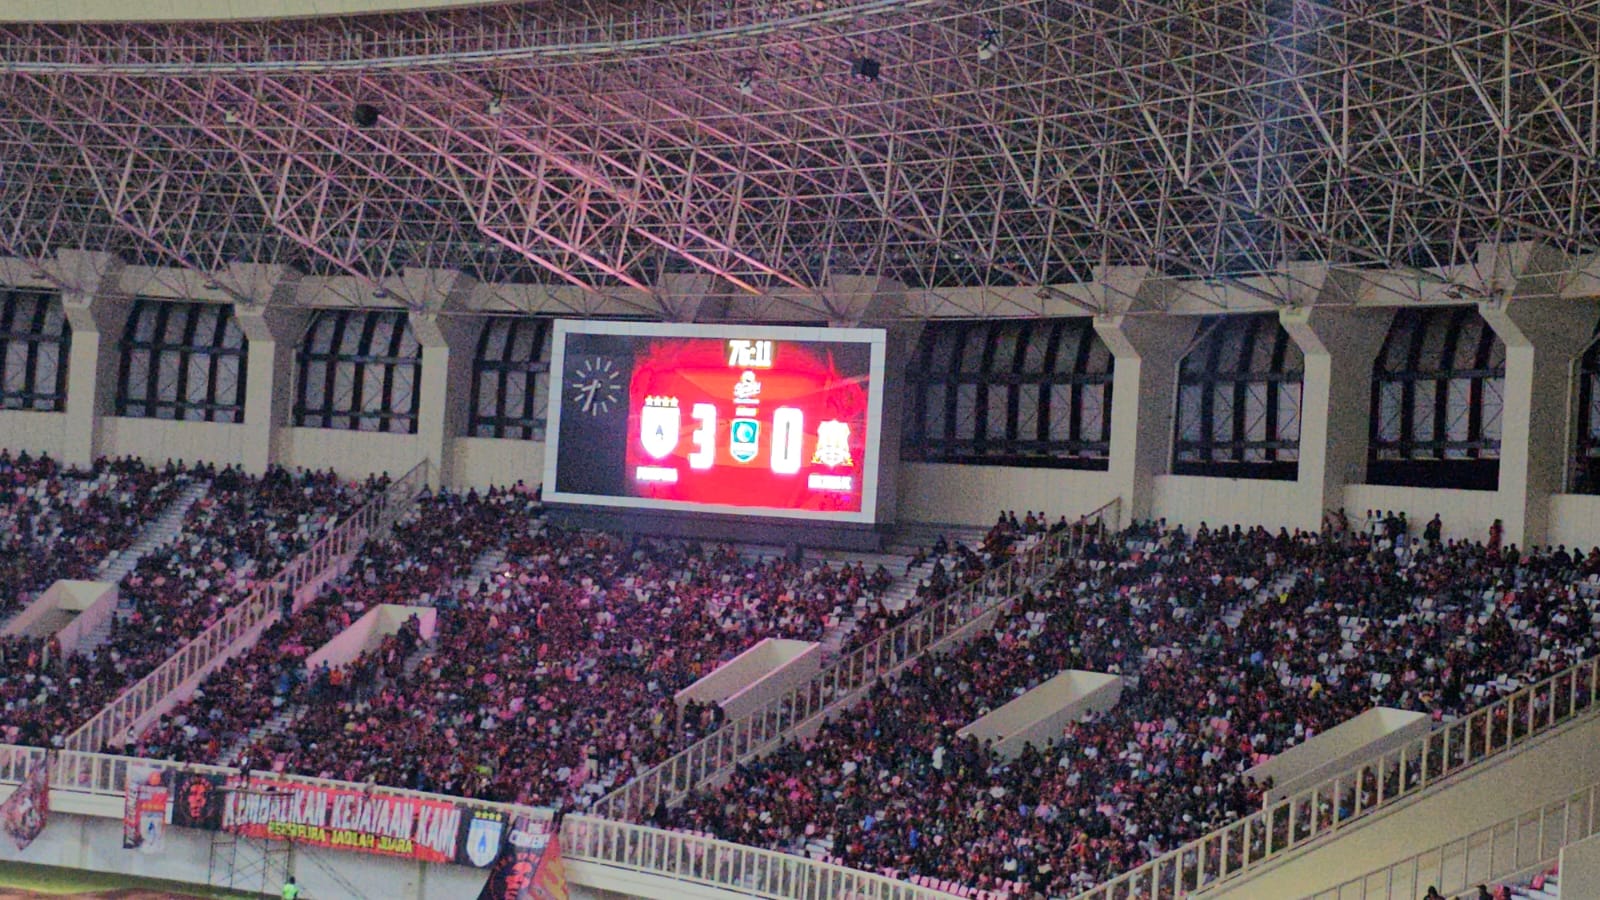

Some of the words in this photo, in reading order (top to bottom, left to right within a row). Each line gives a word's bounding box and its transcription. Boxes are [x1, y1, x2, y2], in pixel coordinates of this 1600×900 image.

[728, 339, 772, 367] 76:11
[689, 404, 717, 469] 3
[772, 408, 803, 473] 0
